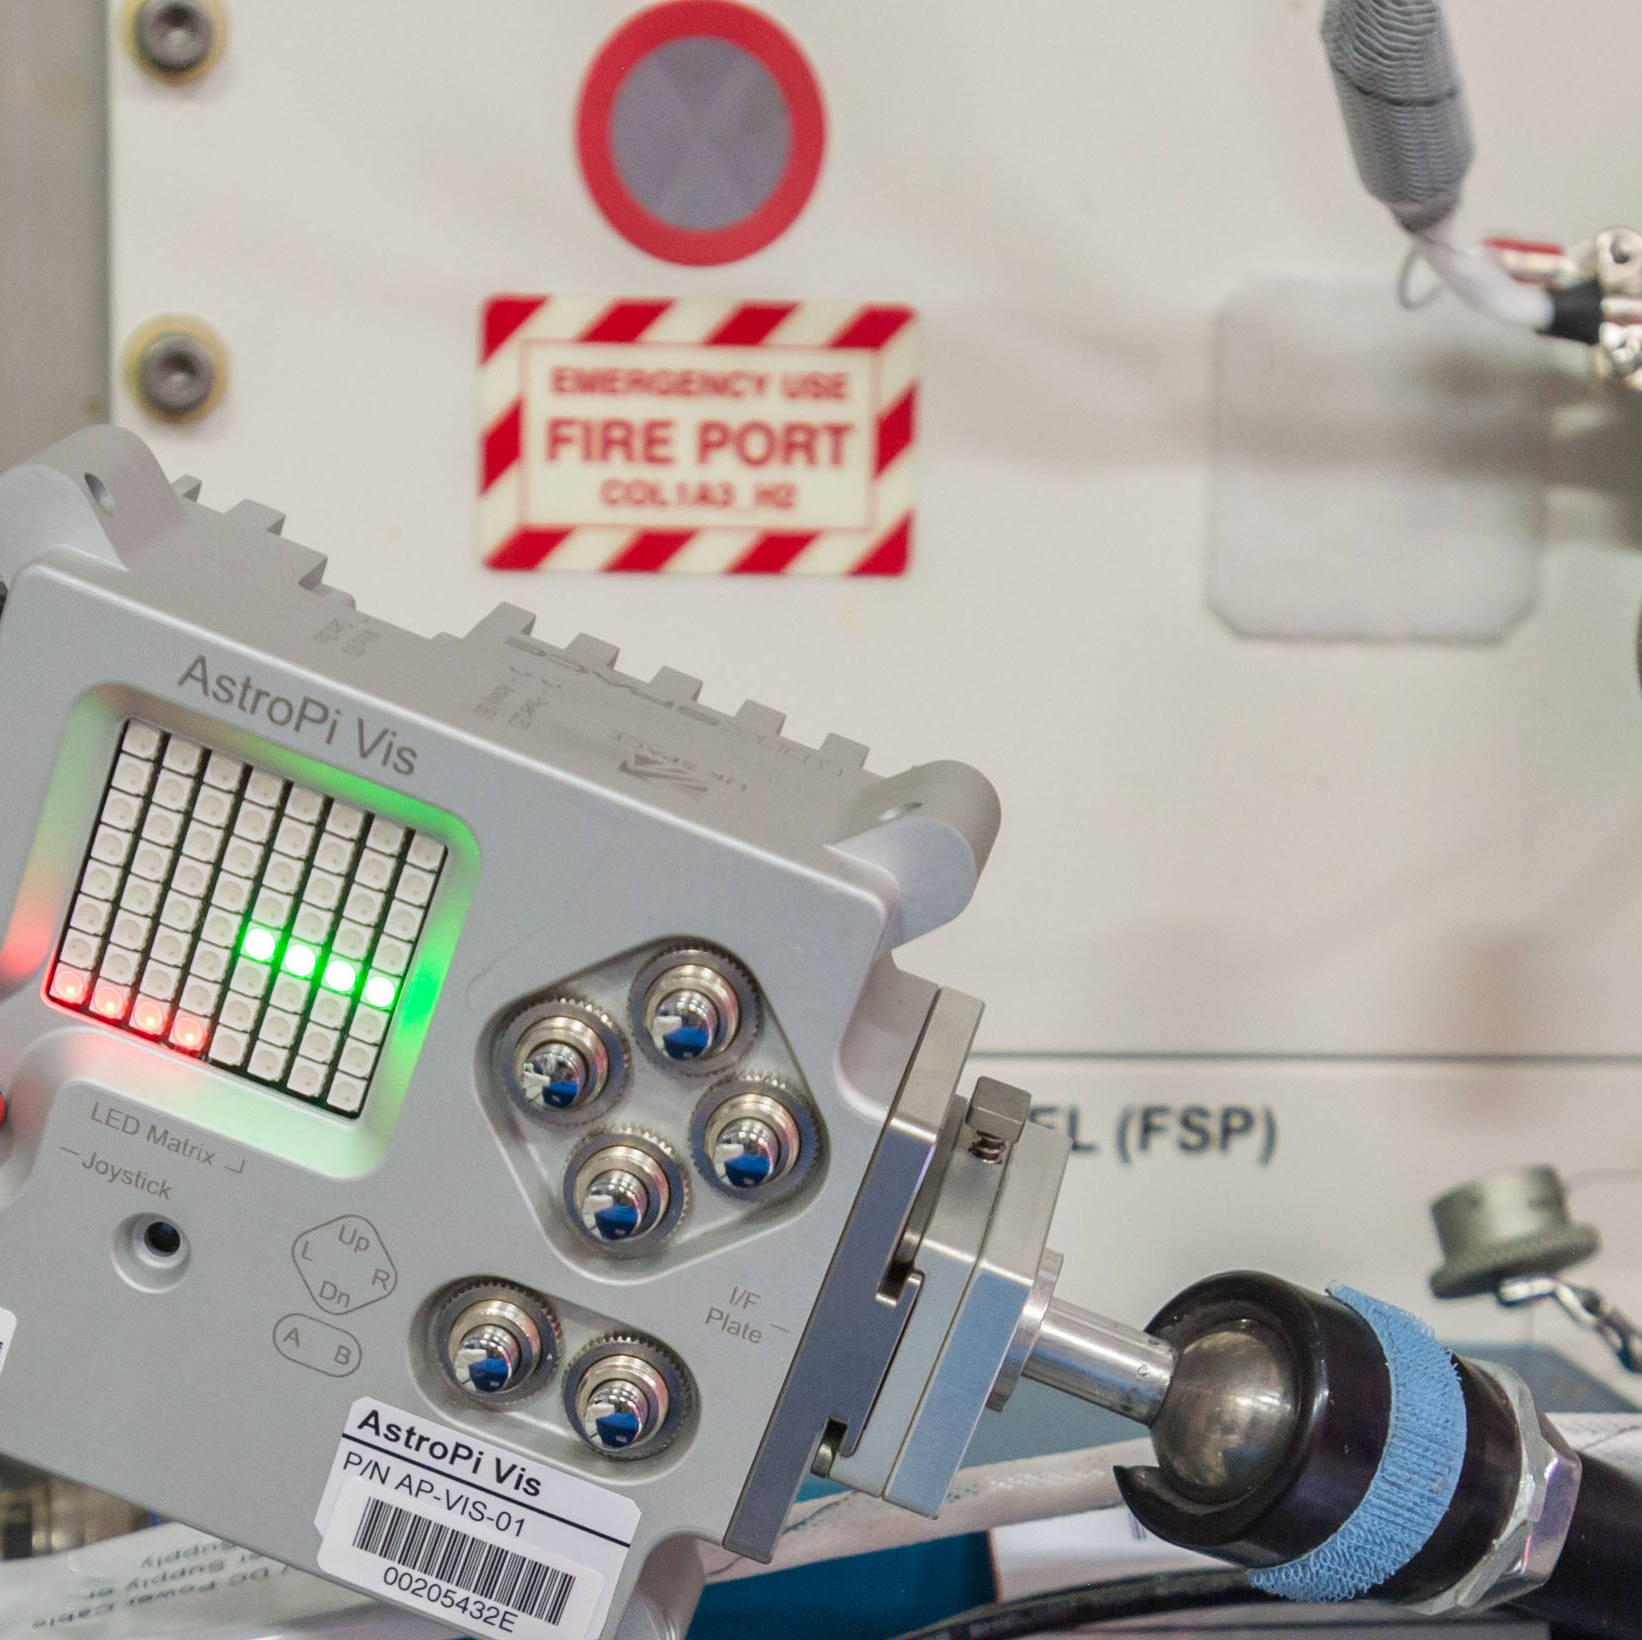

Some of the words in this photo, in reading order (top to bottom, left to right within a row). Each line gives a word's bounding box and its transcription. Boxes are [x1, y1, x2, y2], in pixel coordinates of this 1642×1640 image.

[550, 367, 768, 402] EMERGENCY
[782, 372, 853, 403] USE
[545, 419, 675, 465] FIRE
[696, 421, 856, 469] PORT
[178, 653, 342, 746] AstroPi
[357, 717, 420, 777] Vis
[90, 1101, 141, 1136] LED
[145, 1123, 217, 1167] Matrix
[1116, 1104, 1278, 1165] (FSP)
[81, 1151, 173, 1201] Joystick
[338, 1224, 371, 1253] Up
[300, 1240, 315, 1262] L
[370, 1268, 392, 1292] R
[318, 1280, 352, 1308] Dn
[728, 1285, 762, 1311] I/F
[282, 1326, 301, 1349] A
[333, 1344, 353, 1366] B
[704, 1307, 764, 1345] Plate
[356, 1408, 485, 1474] AstroPi
[493, 1456, 543, 1498] Vis
[342, 1450, 392, 1487] P/N
[394, 1473, 526, 1538] AP-VIS-01
[32, 1601, 115, 1630] Cable
[382, 1566, 520, 1635] 00205432E
